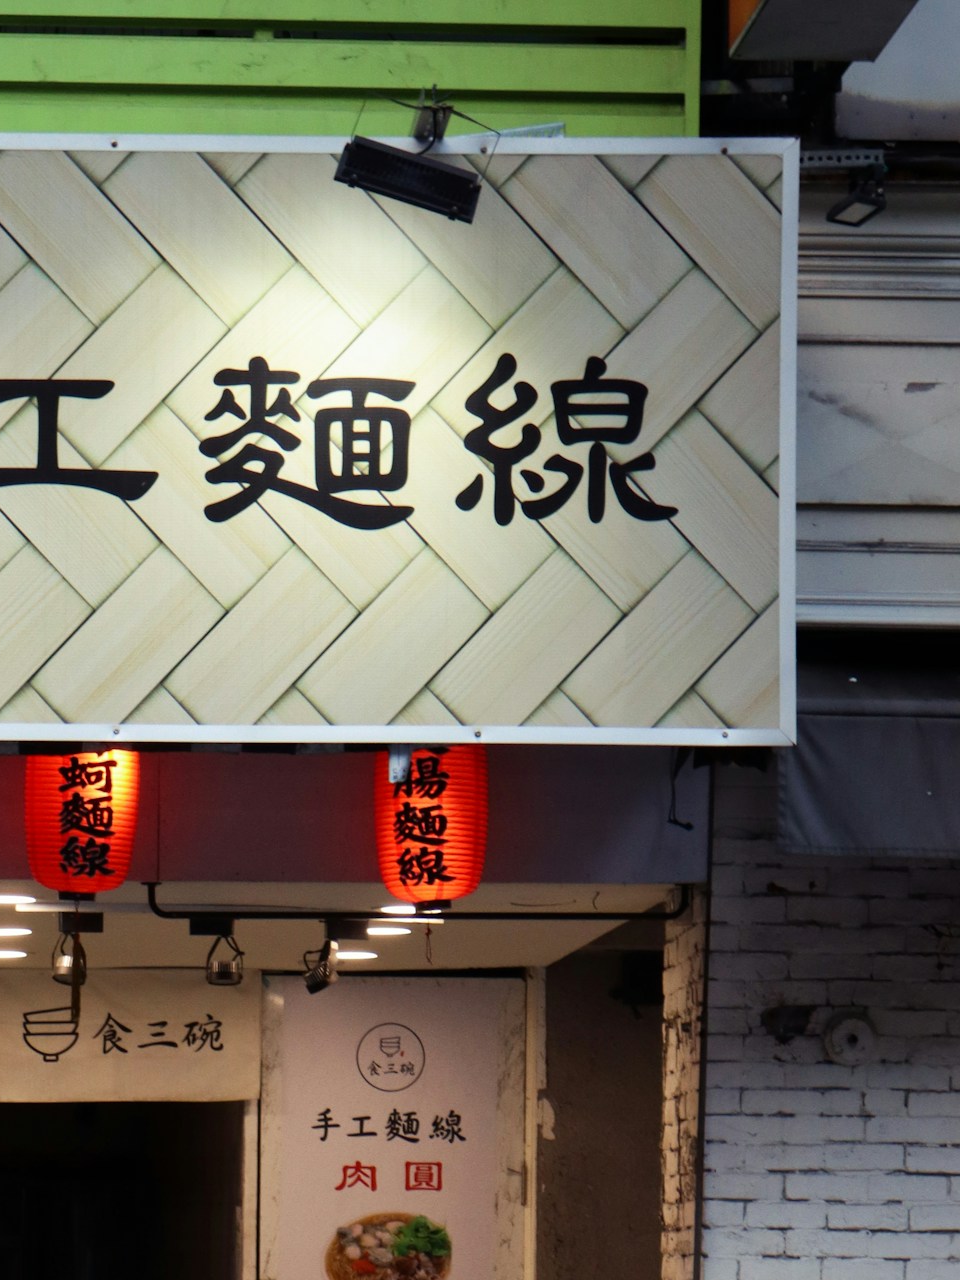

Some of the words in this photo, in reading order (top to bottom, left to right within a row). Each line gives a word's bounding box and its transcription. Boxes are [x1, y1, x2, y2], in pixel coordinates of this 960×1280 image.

[92, 1011, 225, 1055] 食三碗
[367, 1060, 416, 1077] 食三碗
[311, 1107, 467, 1144] 手工麵線
[334, 1160, 443, 1192] 肉圓
